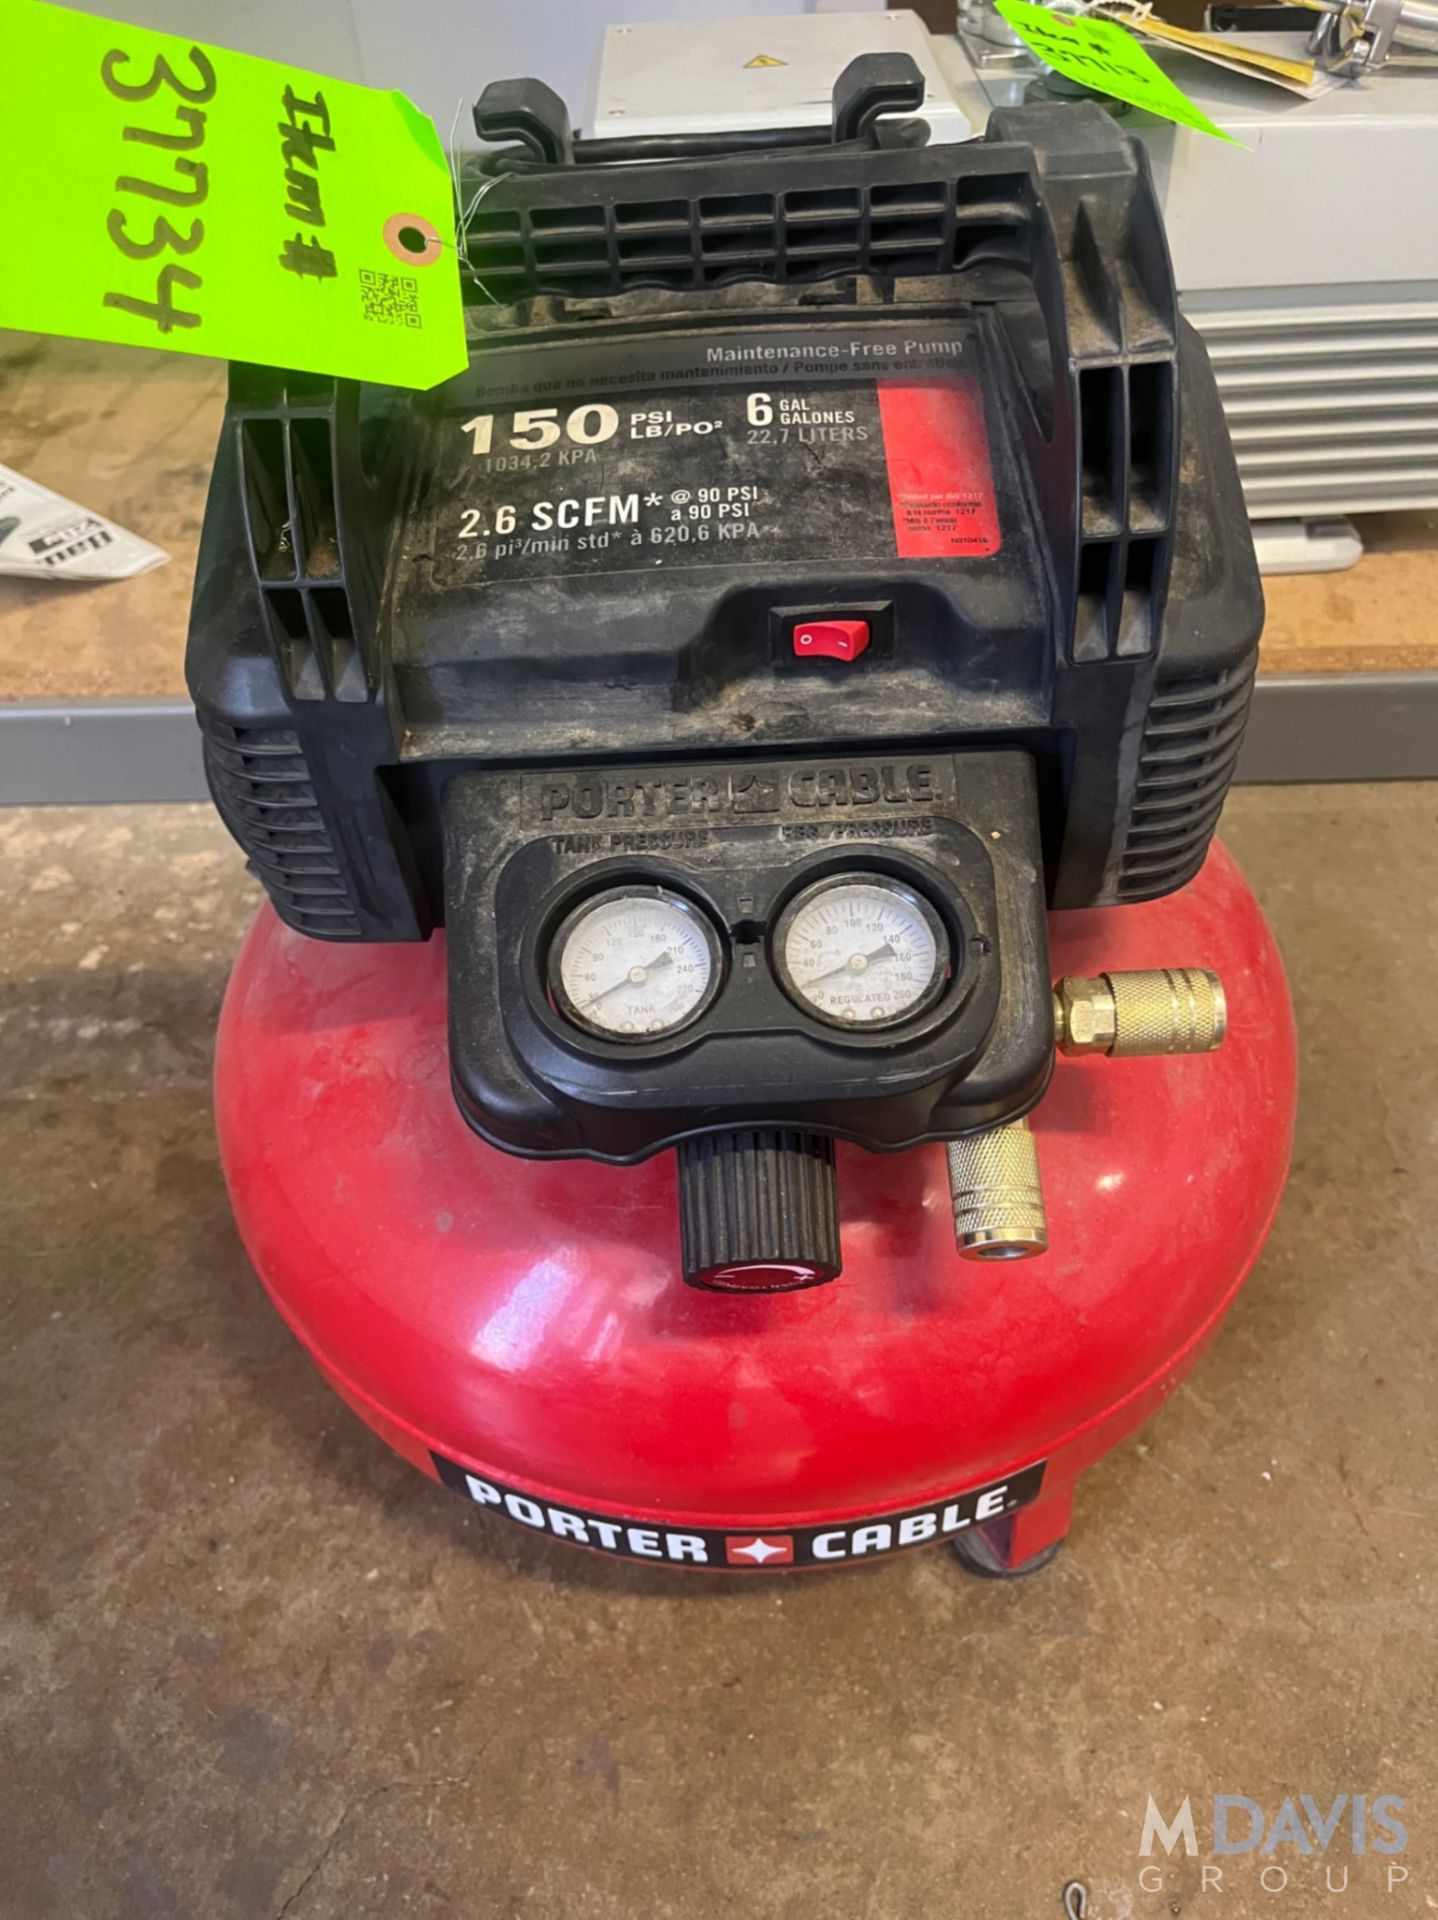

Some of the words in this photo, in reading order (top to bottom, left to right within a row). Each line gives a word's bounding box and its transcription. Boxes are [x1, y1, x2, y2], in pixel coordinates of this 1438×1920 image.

[100, 46, 216, 333] 37734
[706, 341, 897, 363] Maintenance-Free
[904, 340, 963, 357] Pump
[533, 381, 561, 393] que
[566, 379, 585, 389] no
[590, 370, 656, 386] necesita
[660, 363, 778, 381] mantenimiento
[747, 392, 773, 426] 6
[780, 399, 810, 411] GAL
[631, 410, 672, 425] PSI
[780, 411, 855, 425] GALONES
[460, 404, 620, 455] 150
[798, 426, 868, 443] LITERS
[559, 448, 597, 465] KPA
[671, 489, 691, 504] @
[698, 488, 720, 503] 90
[728, 486, 757, 501] PSI
[671, 509, 681, 521] a
[688, 504, 711, 520] 90
[719, 503, 749, 518] PSI
[458, 505, 516, 538] 2.6
[630, 529, 642, 545] à
[651, 524, 710, 544] 620,6
[719, 521, 760, 541] KPA
[541, 776, 721, 821] PORTER
[552, 834, 600, 854] TANK
[610, 830, 709, 851] PRESSURE
[826, 926, 838, 935] 80
[845, 918, 862, 927] 100
[866, 922, 884, 932] 120
[810, 940, 822, 949] 60
[883, 934, 900, 943] 140
[803, 958, 814, 967] 40
[895, 953, 911, 962] 160
[676, 964, 693, 973] 240
[830, 992, 891, 1005] REGULATED
[627, 1005, 656, 1015] TANK
[465, 1473, 708, 1563] PORTER
